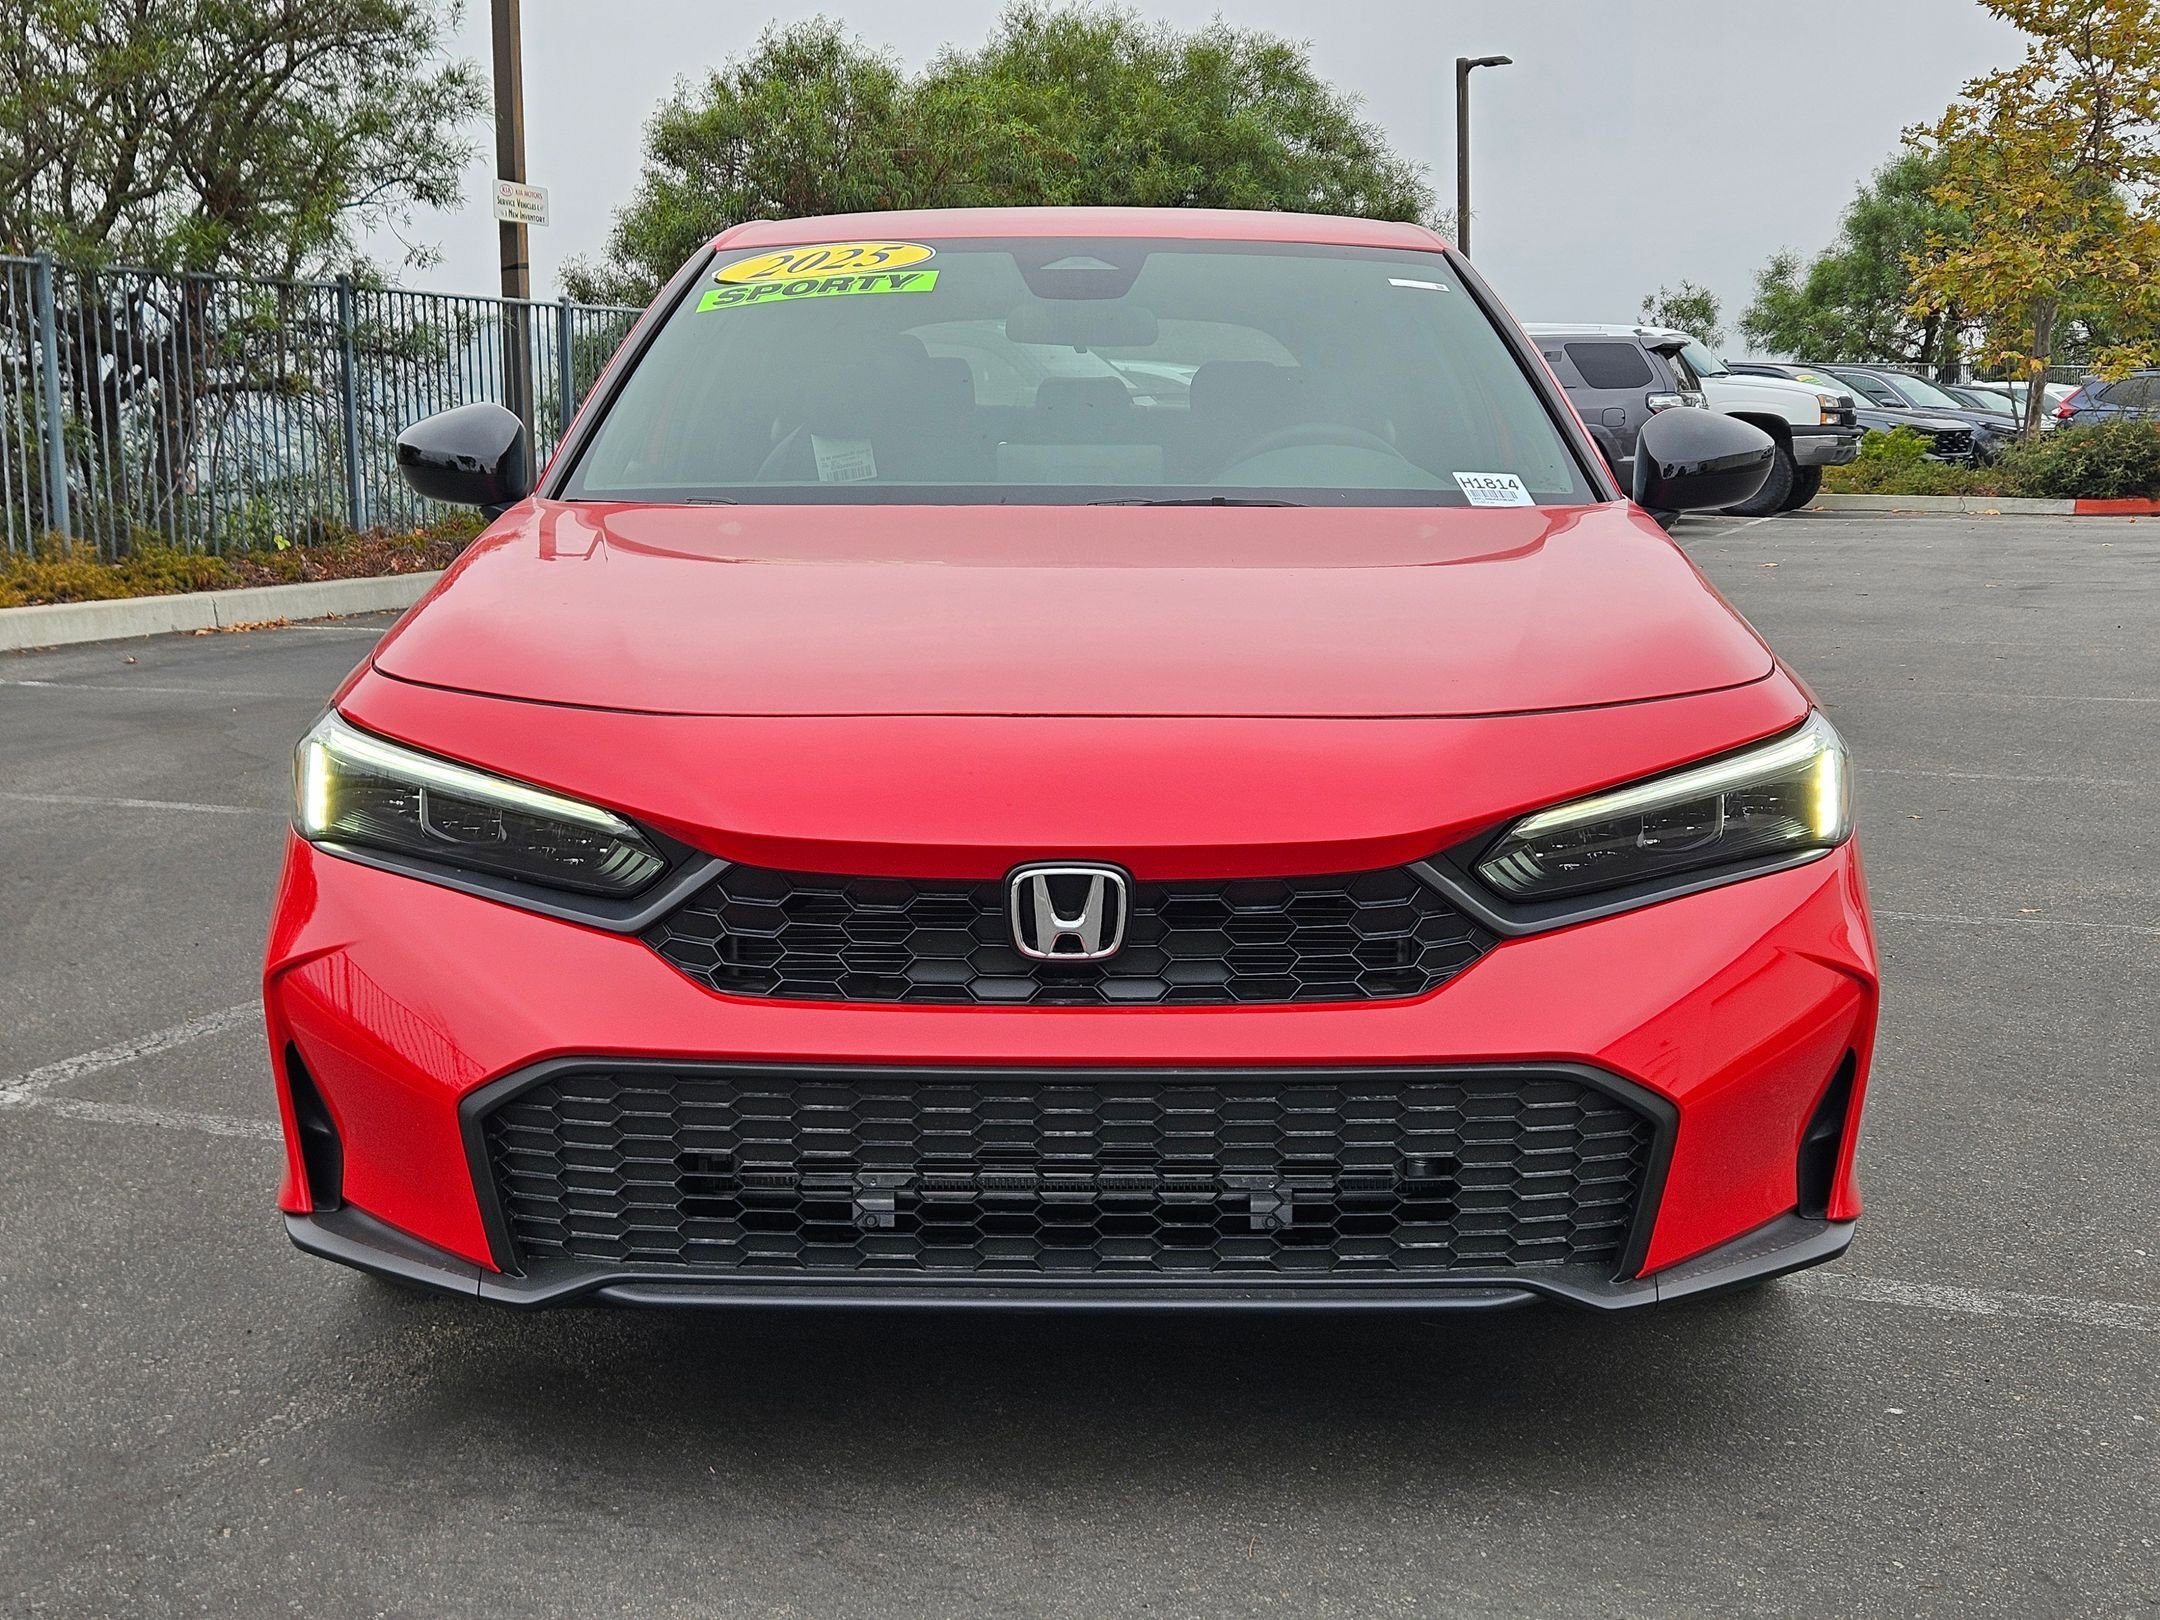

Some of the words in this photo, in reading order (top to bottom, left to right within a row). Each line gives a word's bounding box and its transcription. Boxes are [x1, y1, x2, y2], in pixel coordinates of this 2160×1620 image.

[747, 246, 905, 278] 2025
[713, 273, 924, 306] SPORTY
[1459, 477, 1519, 490] H1814
